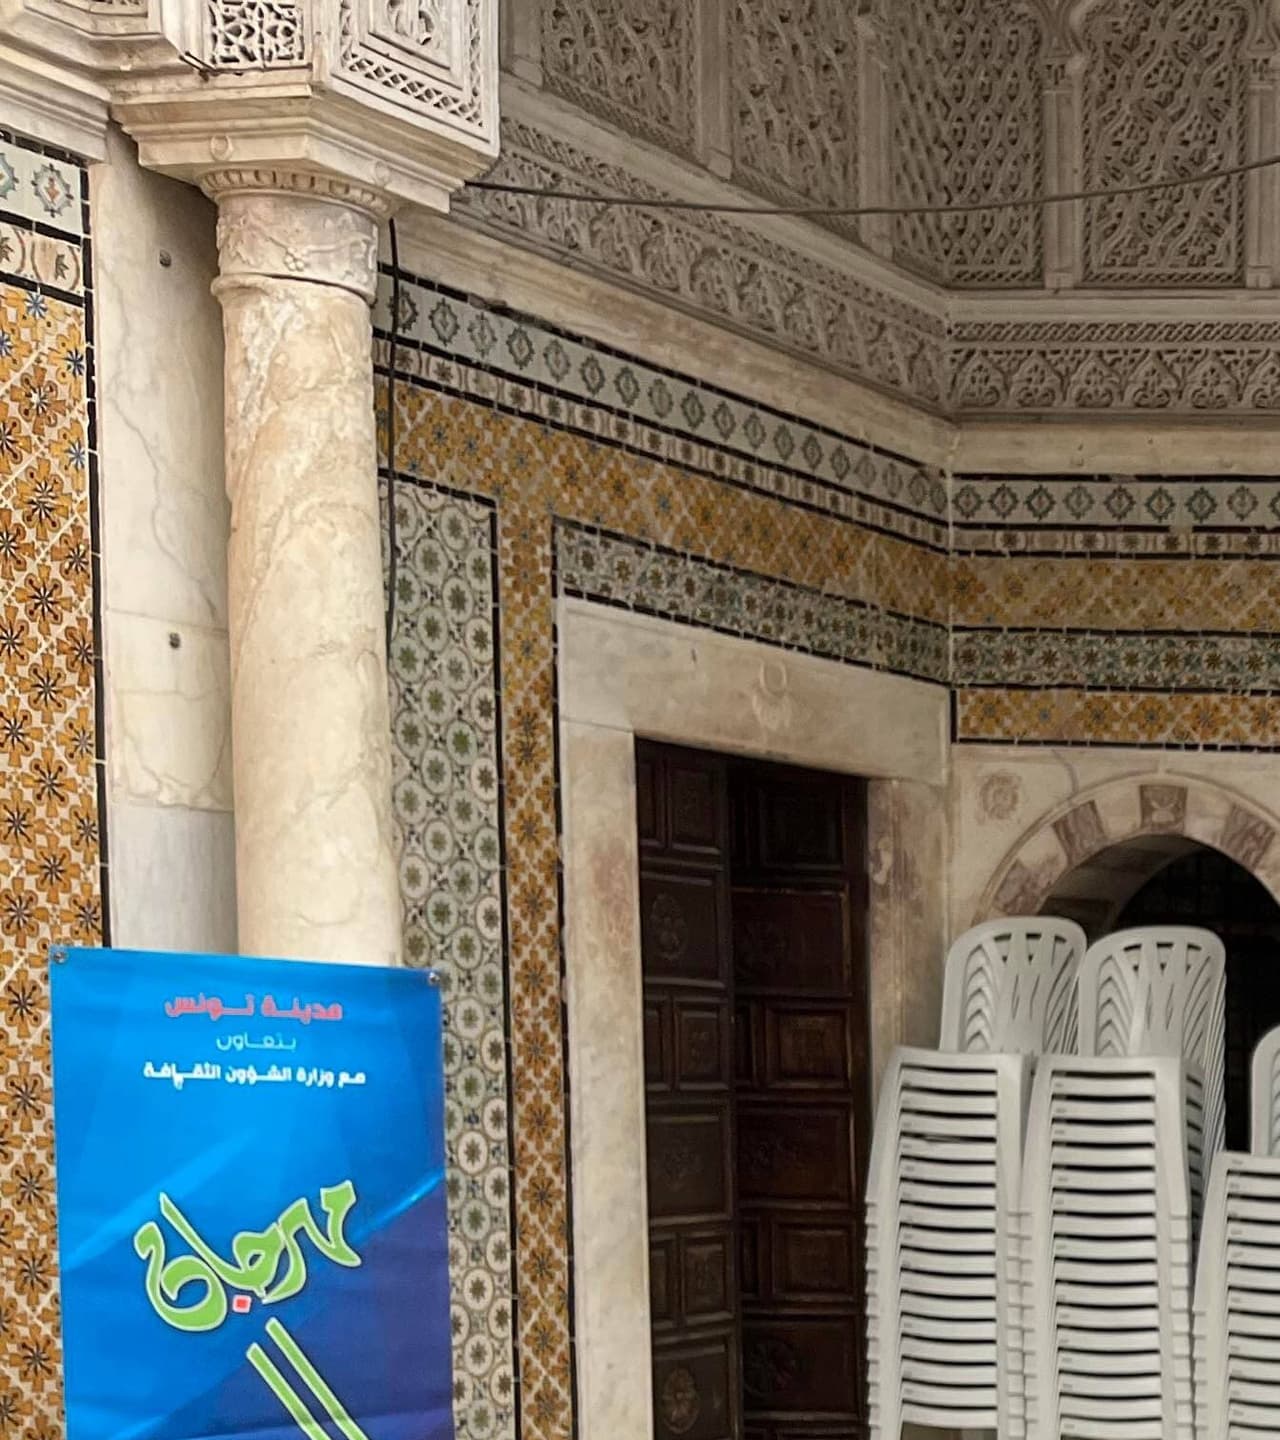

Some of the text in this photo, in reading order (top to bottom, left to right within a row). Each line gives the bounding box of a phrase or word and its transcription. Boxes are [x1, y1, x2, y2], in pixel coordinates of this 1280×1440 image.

[164, 992, 344, 1025] مدينة تونس
[224, 1063, 293, 1085] الشؤون
[295, 1066, 335, 1088] وزارة
[337, 1071, 367, 1088] مع
[134, 1180, 362, 1332] مهرجان
